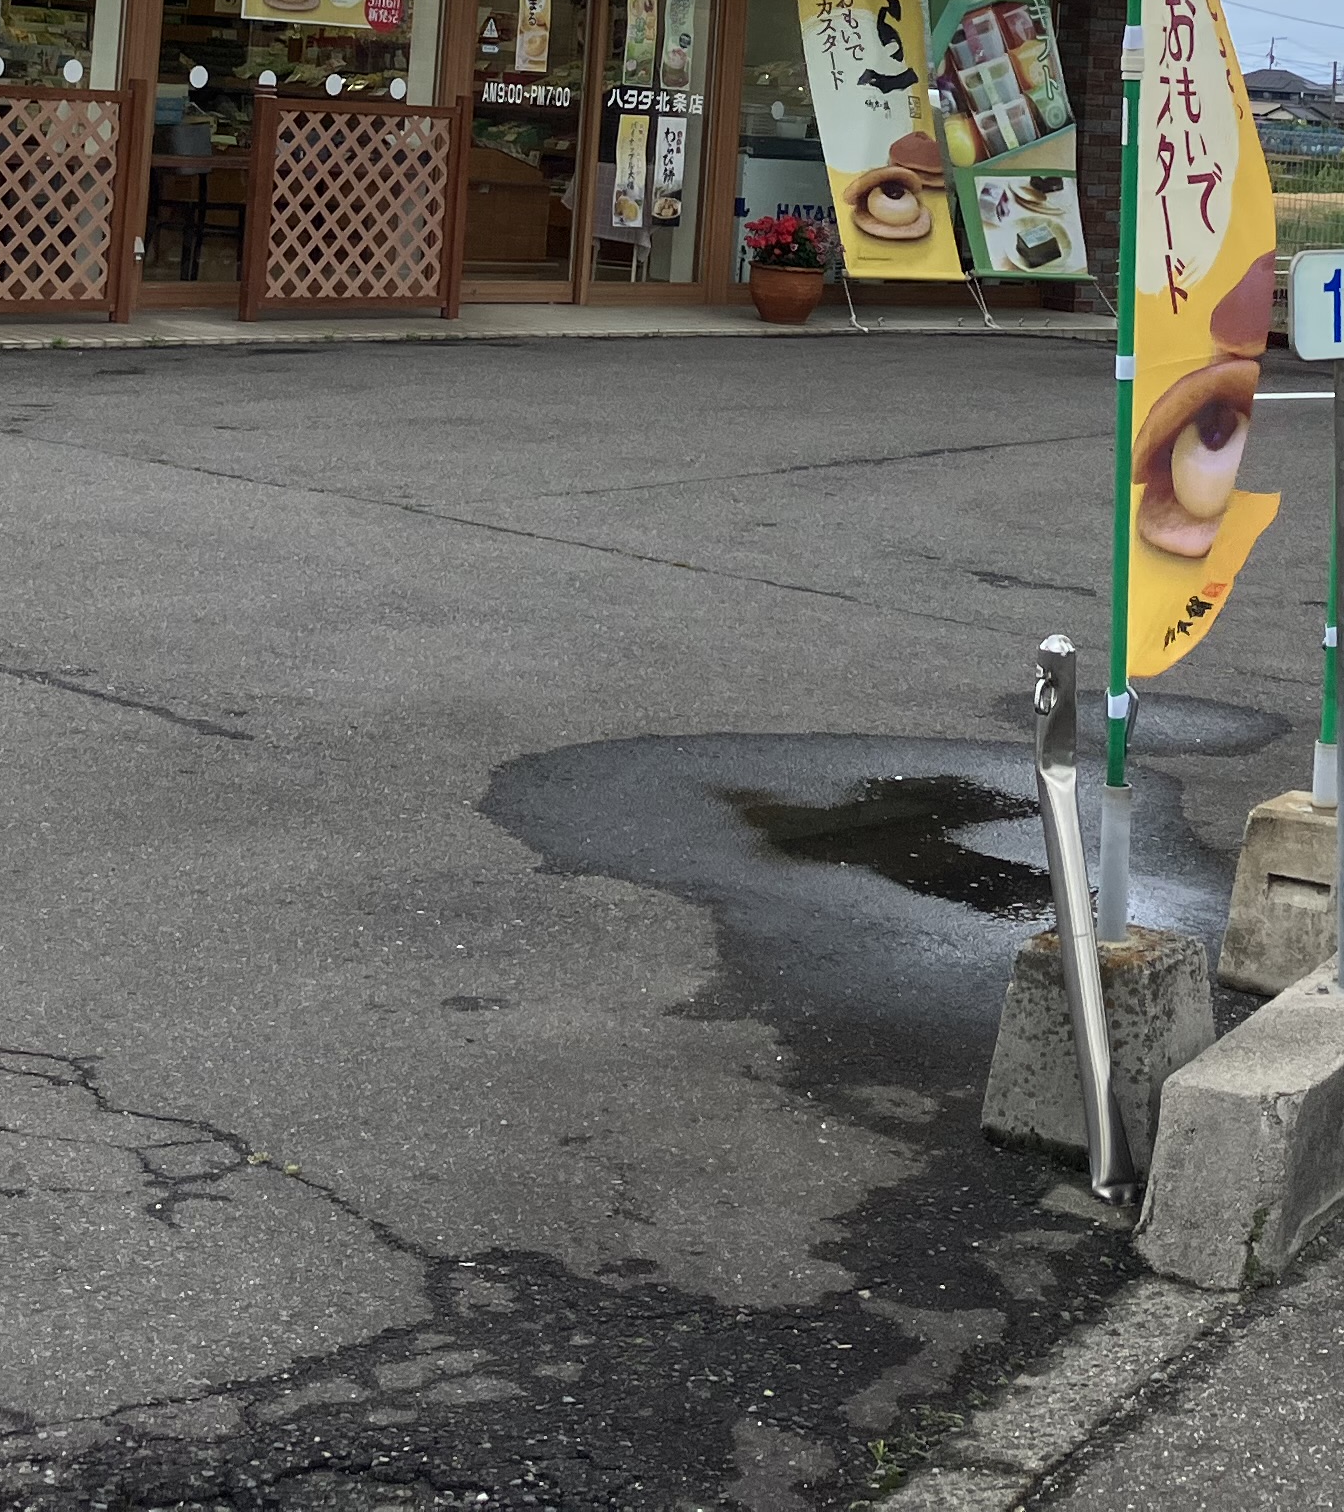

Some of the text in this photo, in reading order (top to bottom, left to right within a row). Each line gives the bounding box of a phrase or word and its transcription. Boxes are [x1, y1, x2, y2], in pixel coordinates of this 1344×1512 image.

[607, 88, 704, 115] ハタダ北条店
[662, 127, 676, 184] わらび餅
